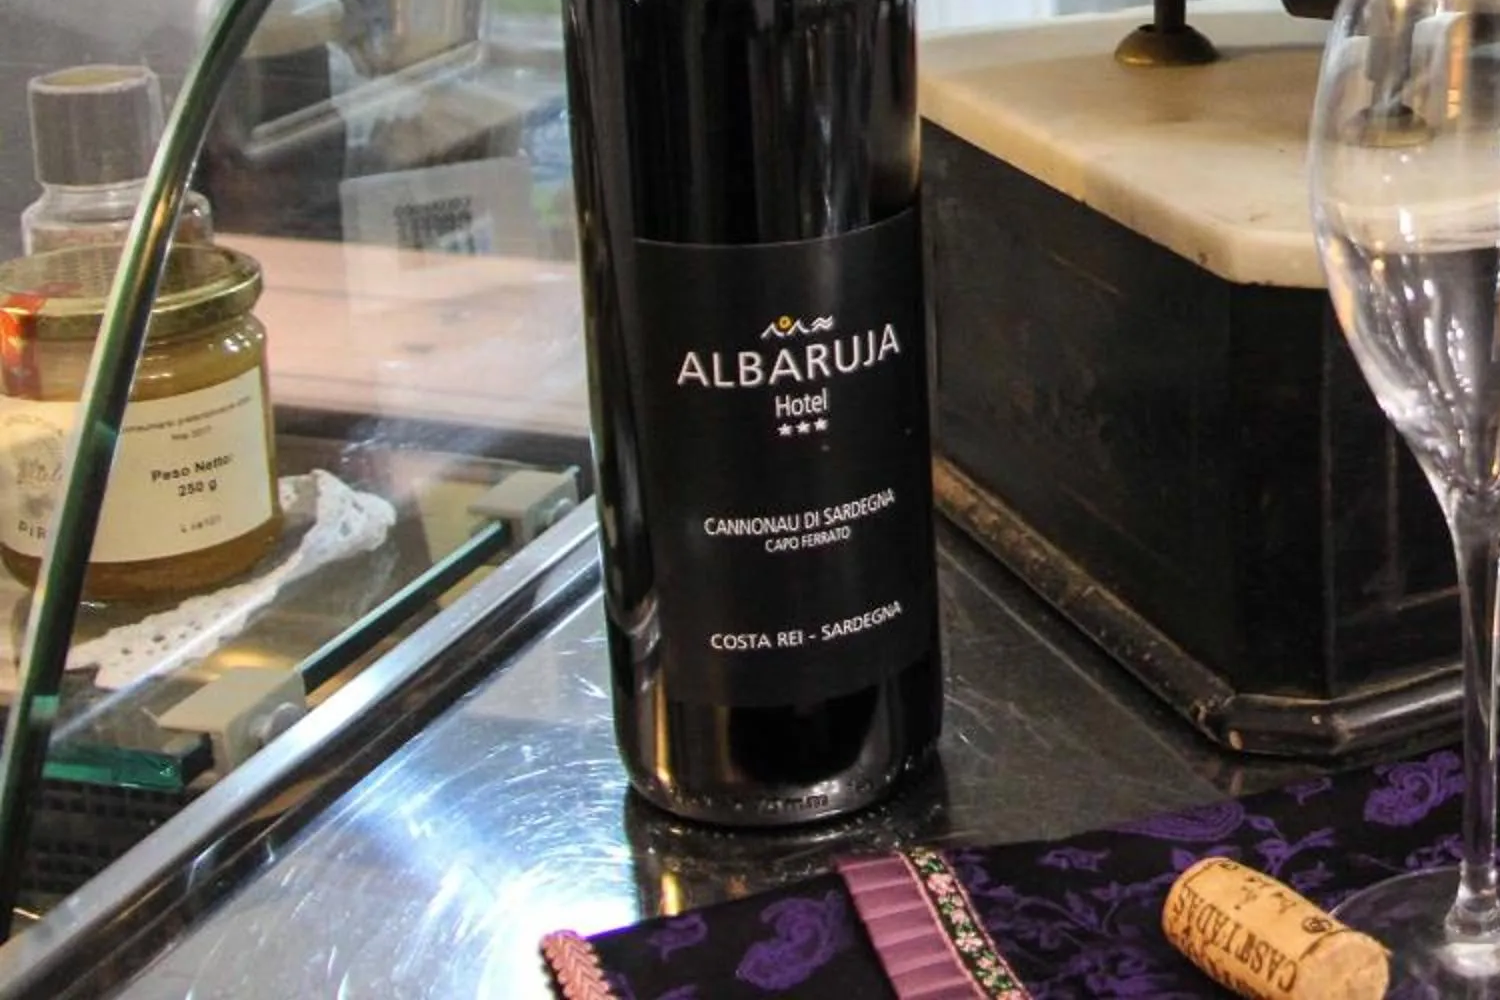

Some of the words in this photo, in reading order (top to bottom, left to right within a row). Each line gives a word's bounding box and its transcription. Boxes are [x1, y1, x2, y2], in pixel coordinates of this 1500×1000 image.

[677, 322, 900, 388] ALBARUJA
[775, 387, 828, 418] Hotel
[703, 513, 800, 537] CANNONAU
[803, 510, 820, 530] DI
[823, 487, 896, 526] SARDEGNA
[765, 536, 799, 553] CAPO
[801, 525, 851, 548] FERRATO
[710, 632, 772, 650] COSTA
[777, 629, 804, 648] REI
[821, 600, 901, 642] SARDEGNA
